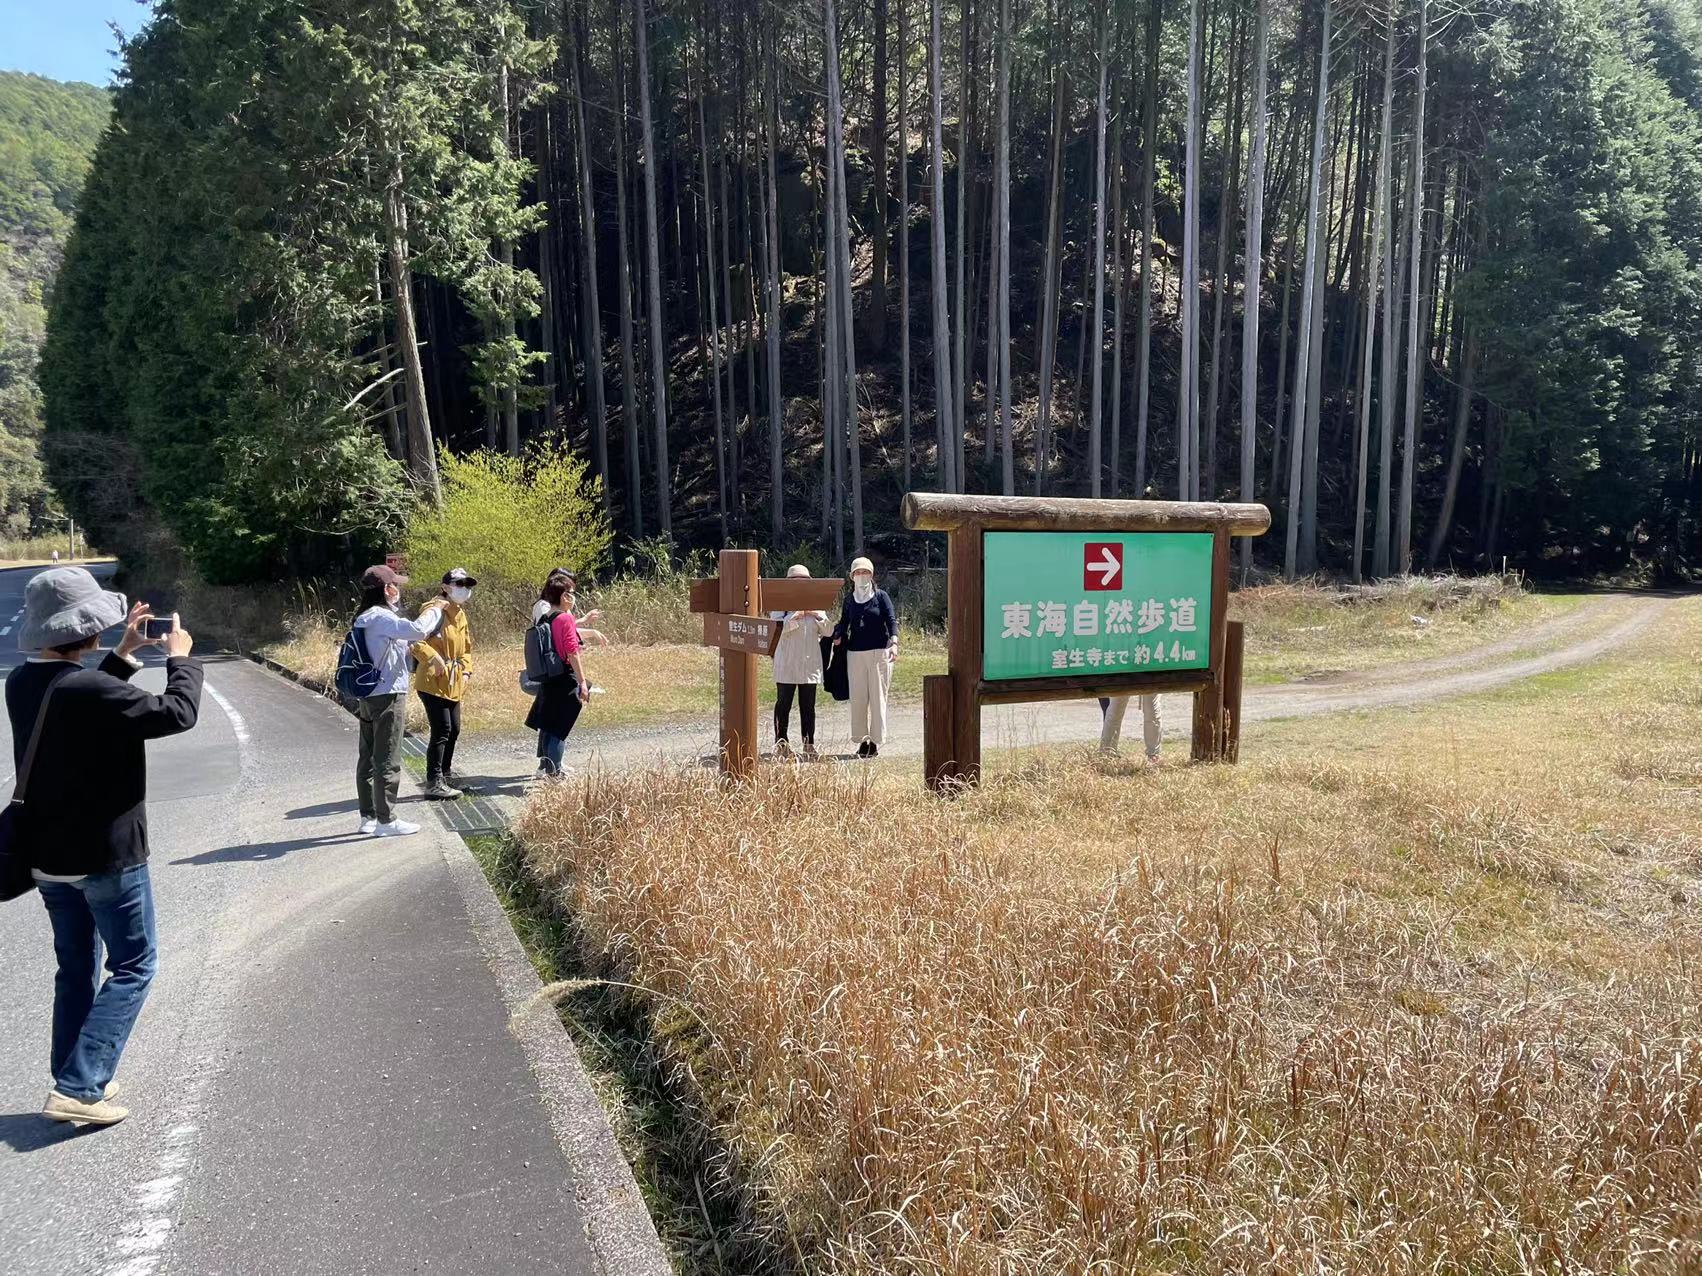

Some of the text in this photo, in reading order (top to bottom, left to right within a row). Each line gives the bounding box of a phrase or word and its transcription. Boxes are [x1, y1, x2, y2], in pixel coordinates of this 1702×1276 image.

[1001, 598, 1197, 638] 東海自然歩道
